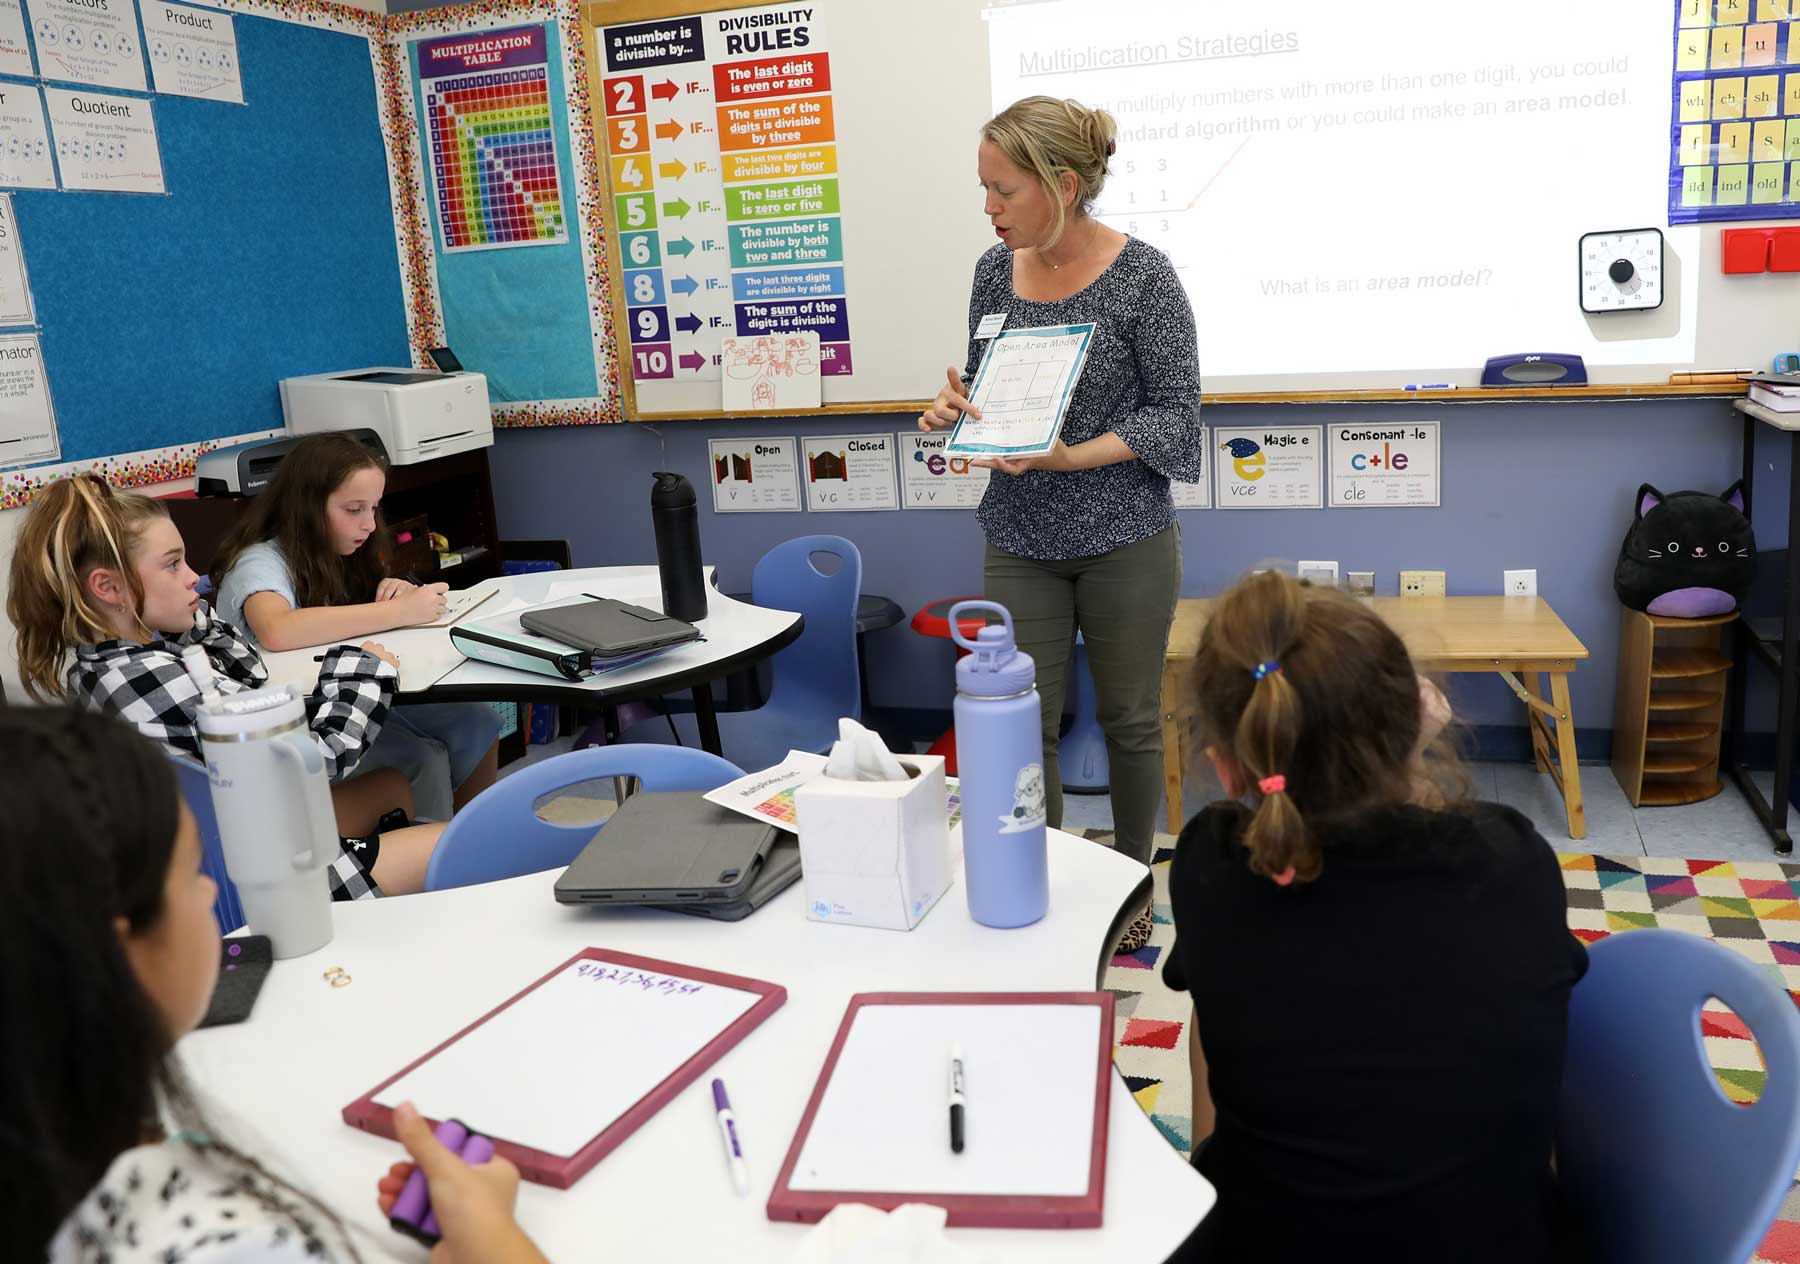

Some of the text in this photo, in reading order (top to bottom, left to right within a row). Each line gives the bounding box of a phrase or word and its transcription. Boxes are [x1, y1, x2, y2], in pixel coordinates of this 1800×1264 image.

[166, 9, 213, 30] Product
[719, 8, 813, 32] DIVISIBILITY
[614, 26, 692, 47] a number is
[726, 26, 809, 55] RULES
[432, 35, 532, 59] MULTIPLICATION
[616, 44, 693, 61] divisible by...
[1019, 29, 1298, 75] Multiplication Strategies
[1688, 41, 1766, 56] s t u
[464, 51, 502, 66] TABLE
[728, 60, 814, 80] The last digit
[731, 77, 813, 93] is even or zero
[1117, 56, 1628, 114] multiply numbers with more than one digit, you could
[614, 82, 710, 112] 2 IF...
[1686, 96, 1704, 106] wh
[1754, 92, 1769, 102] sh
[72, 98, 130, 118] Quotient
[728, 102, 821, 120] The sum of the
[1118, 88, 1632, 145] ndard algorithm or you could make an area model.
[730, 116, 821, 134] digits is divisible
[618, 120, 713, 149] 3 IF...
[752, 131, 801, 145] by three
[1764, 136, 1773, 146] s
[621, 159, 717, 188] 4 IF...
[734, 161, 825, 177] divisible by four
[1127, 158, 1168, 173] 5 3
[739, 184, 823, 201] The last digit
[1722, 180, 1742, 191] ind
[1757, 179, 1777, 189] old
[1128, 189, 1168, 204] 1 1
[626, 198, 721, 227] 5 IF...
[742, 199, 823, 215] is zero or five
[739, 220, 829, 238] The number is
[1129, 219, 1169, 233] 5 3
[742, 234, 829, 249] divisible by both
[630, 236, 725, 264] 6 IF...
[745, 247, 827, 263] two and three
[745, 273, 830, 286] The last three digits
[1260, 268, 1492, 296] What is an area model?
[633, 275, 728, 302] 8 IF...
[746, 284, 832, 296] are divisible by eight
[744, 301, 837, 317] The sum of the
[637, 311, 732, 338] 9 IF...
[748, 315, 836, 329] digits is divisible
[997, 337, 1080, 353] Open Area Model
[637, 351, 667, 374] 10
[1264, 434, 1309, 447] Magic e
[1340, 427, 1426, 441] Consonant -le
[755, 444, 780, 457] Open
[848, 440, 885, 451] Closed
[915, 437, 946, 448] Vowel
